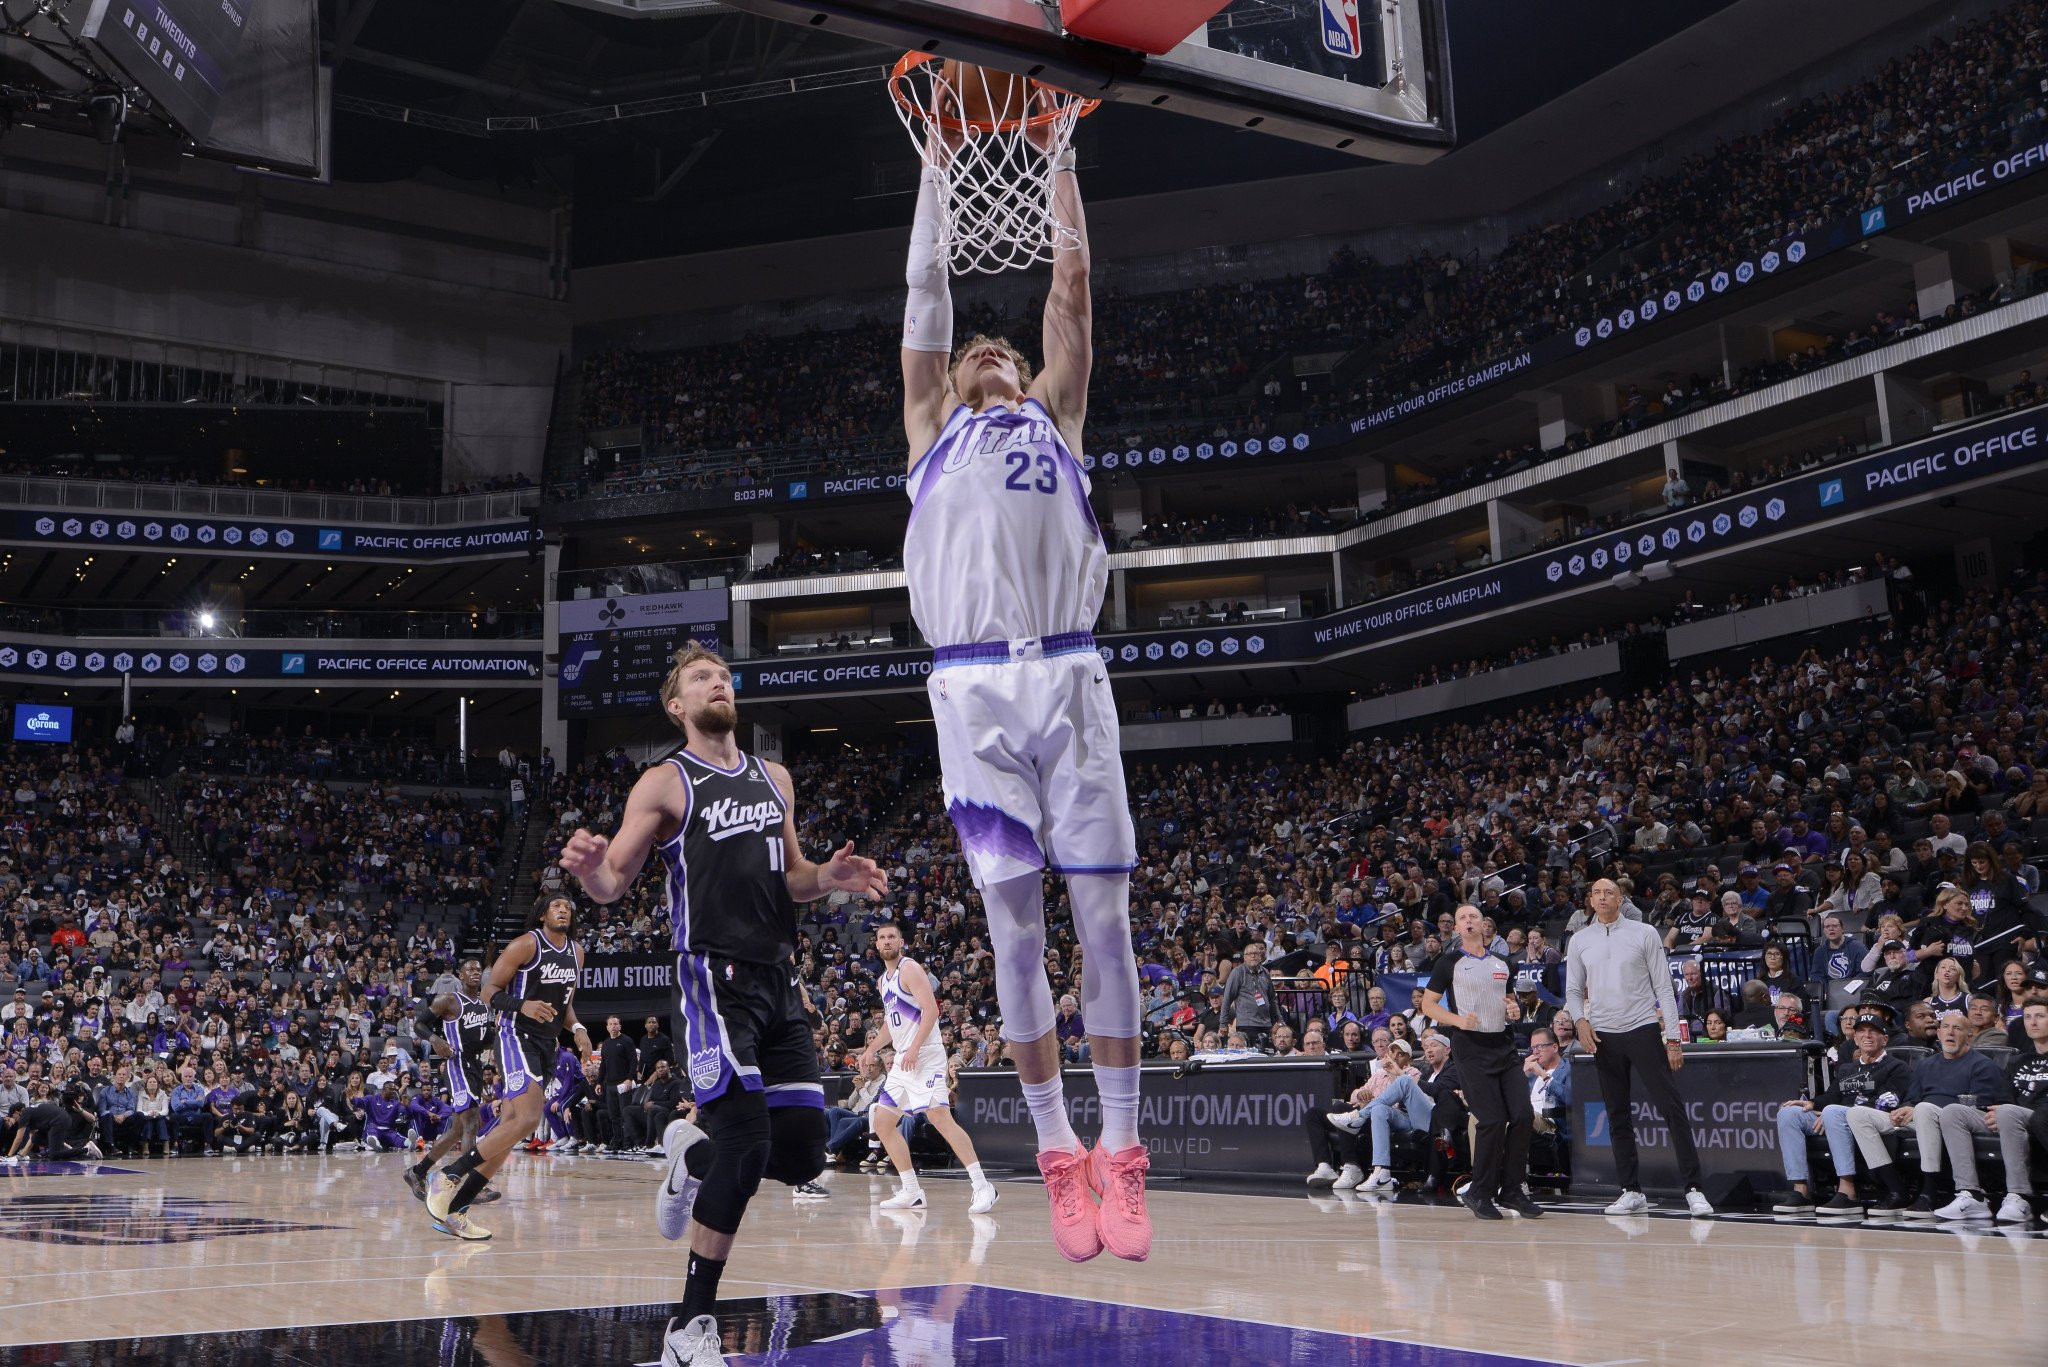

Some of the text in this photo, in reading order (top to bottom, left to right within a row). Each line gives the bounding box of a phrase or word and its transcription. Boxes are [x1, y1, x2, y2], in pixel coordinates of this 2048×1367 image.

[222, 0, 242, 27] BONUS
[156, 7, 197, 59] TIMEOUTS
[1328, 30, 1347, 49] NBA
[1907, 168, 1986, 214] PACIFIC
[1351, 352, 1531, 434] WE HAVE YOUR OFFICE GAMEPLAN
[1865, 427, 2037, 491] PACIFIC OFFICE
[1005, 451, 1058, 495] 23
[734, 488, 773, 501] 8:03 PM
[824, 476, 881, 494] PACIFIC
[355, 529, 545, 549] PACIFIC OFFICE AUTOMATO
[640, 602, 683, 612] REDHAWK
[1314, 580, 1501, 643] WE HAVE YOUR OFFICE GAMEPLAN
[573, 633, 594, 642] JAZZ
[623, 627, 677, 639] HUSTLE STATS
[690, 623, 716, 633] KINGS
[613, 646, 619, 654] 4
[666, 641, 673, 650] 3
[318, 658, 527, 671] PACIFIC OFFICE AUTOMATION
[613, 660, 619, 668] 5
[613, 674, 619, 682] 5
[760, 669, 818, 686] PACIFIC
[823, 665, 880, 682] OFFICE
[27, 718, 59, 731] Corona
[759, 733, 777, 751] 103
[700, 797, 783, 834] Kings
[766, 836, 785, 872] 11
[1947, 943, 1973, 956] PROUD
[540, 963, 576, 985] Kings
[576, 965, 673, 989] TEAM STORE
[890, 1011, 902, 1028] 10
[1860, 1014, 1874, 1022] RV
[694, 1061, 720, 1078] KINGS
[974, 1097, 1033, 1124] PACIFI
[1139, 1093, 1315, 1126] AUTOMATION
[1712, 1102, 1778, 1122] OFFIC
[1633, 1127, 1775, 1149] AUTMATION
